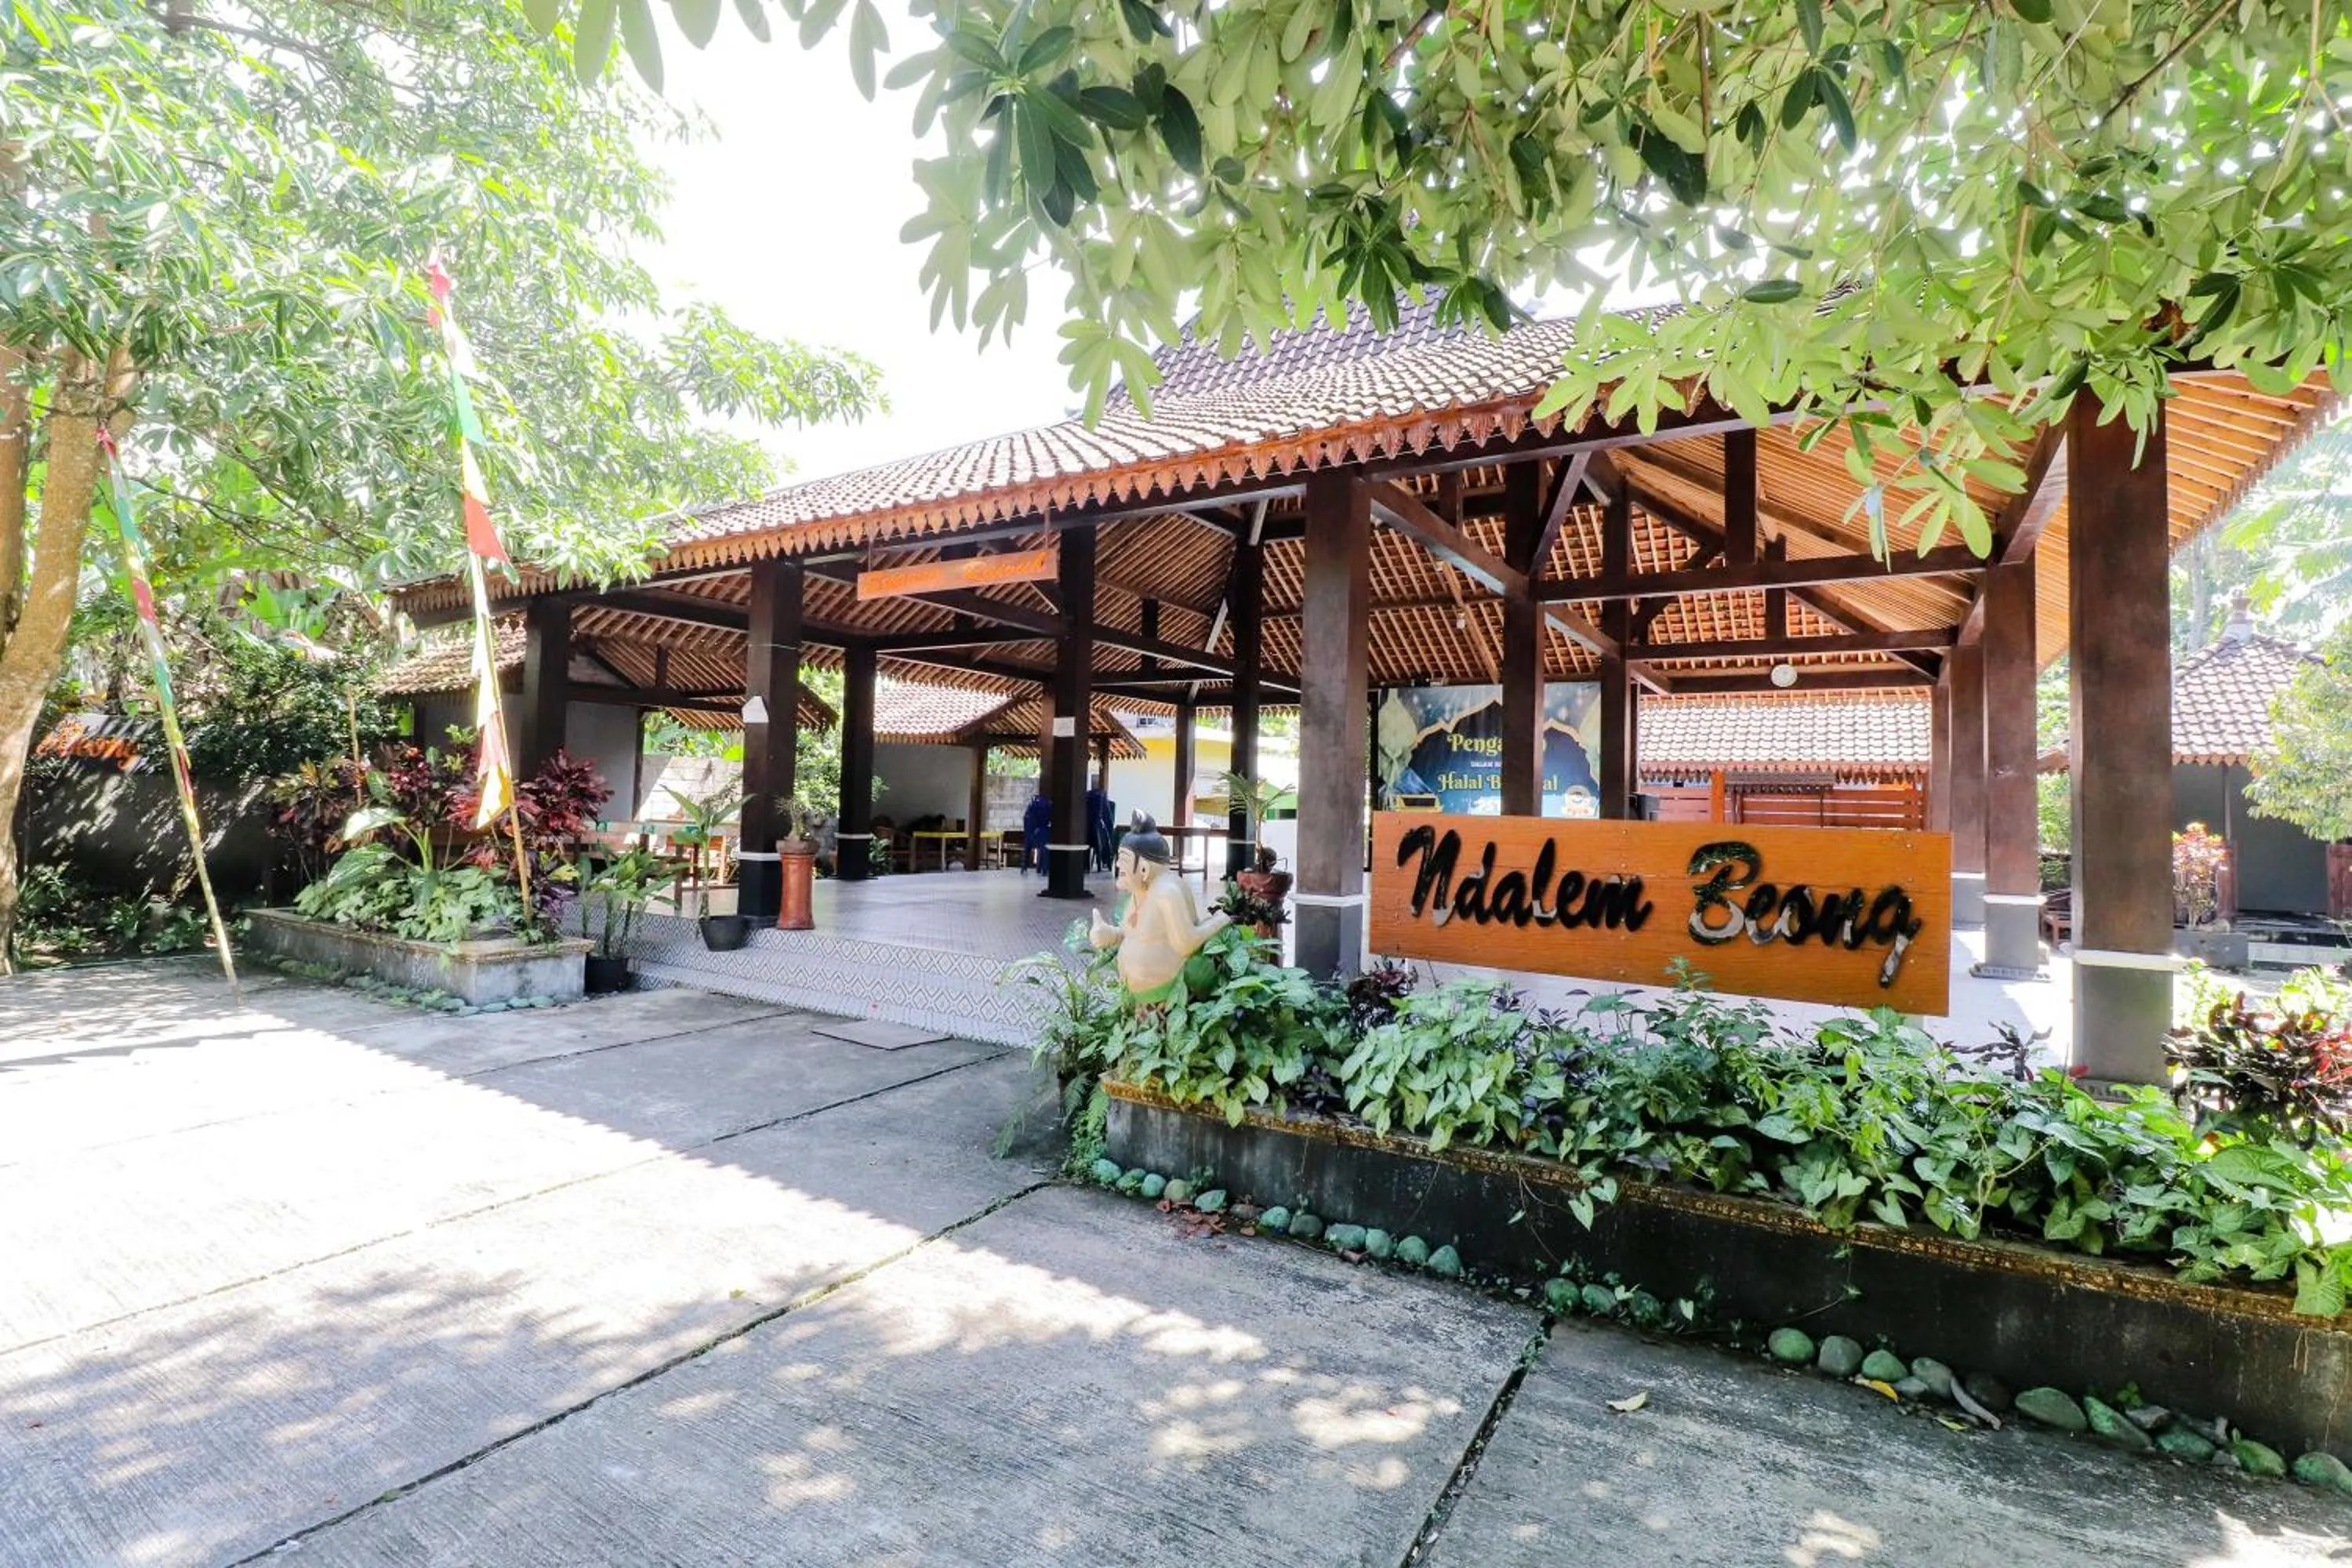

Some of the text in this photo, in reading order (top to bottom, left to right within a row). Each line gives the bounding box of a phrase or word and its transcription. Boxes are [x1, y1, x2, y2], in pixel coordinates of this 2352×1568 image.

[1437, 771, 1483, 792] Halal
[1396, 825, 1922, 989] Ndalem Beong
